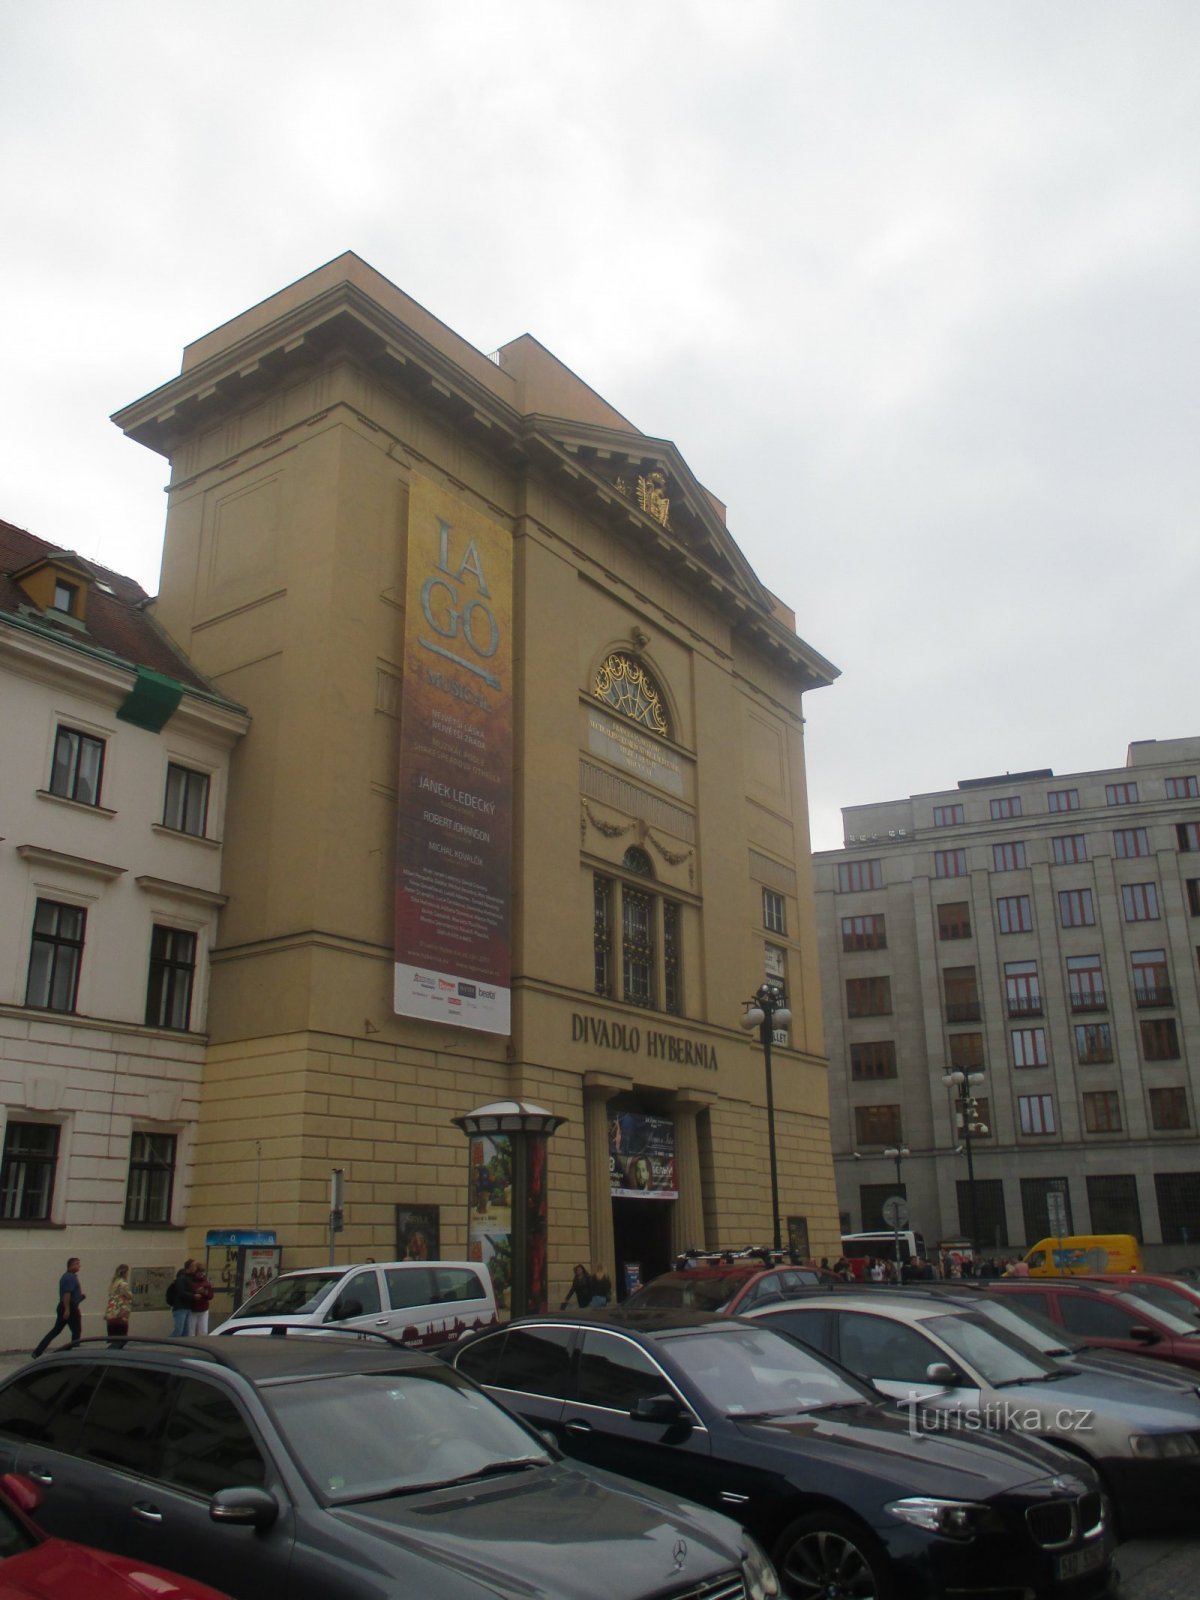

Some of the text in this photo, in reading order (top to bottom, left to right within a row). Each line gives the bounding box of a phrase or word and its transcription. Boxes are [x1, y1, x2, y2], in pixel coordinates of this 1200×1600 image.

[432, 515, 491, 600] IA
[420, 576, 499, 658] GO
[427, 670, 493, 713] MUSICAL
[418, 776, 451, 799] JANEK
[452, 788, 496, 815] LEDECKÝ
[423, 810, 453, 830] ROBERT
[452, 822, 491, 843] JOHANSON
[428, 841, 454, 857] MICHAL
[571, 1012, 719, 1072] DIVADLO HYBERNIA
